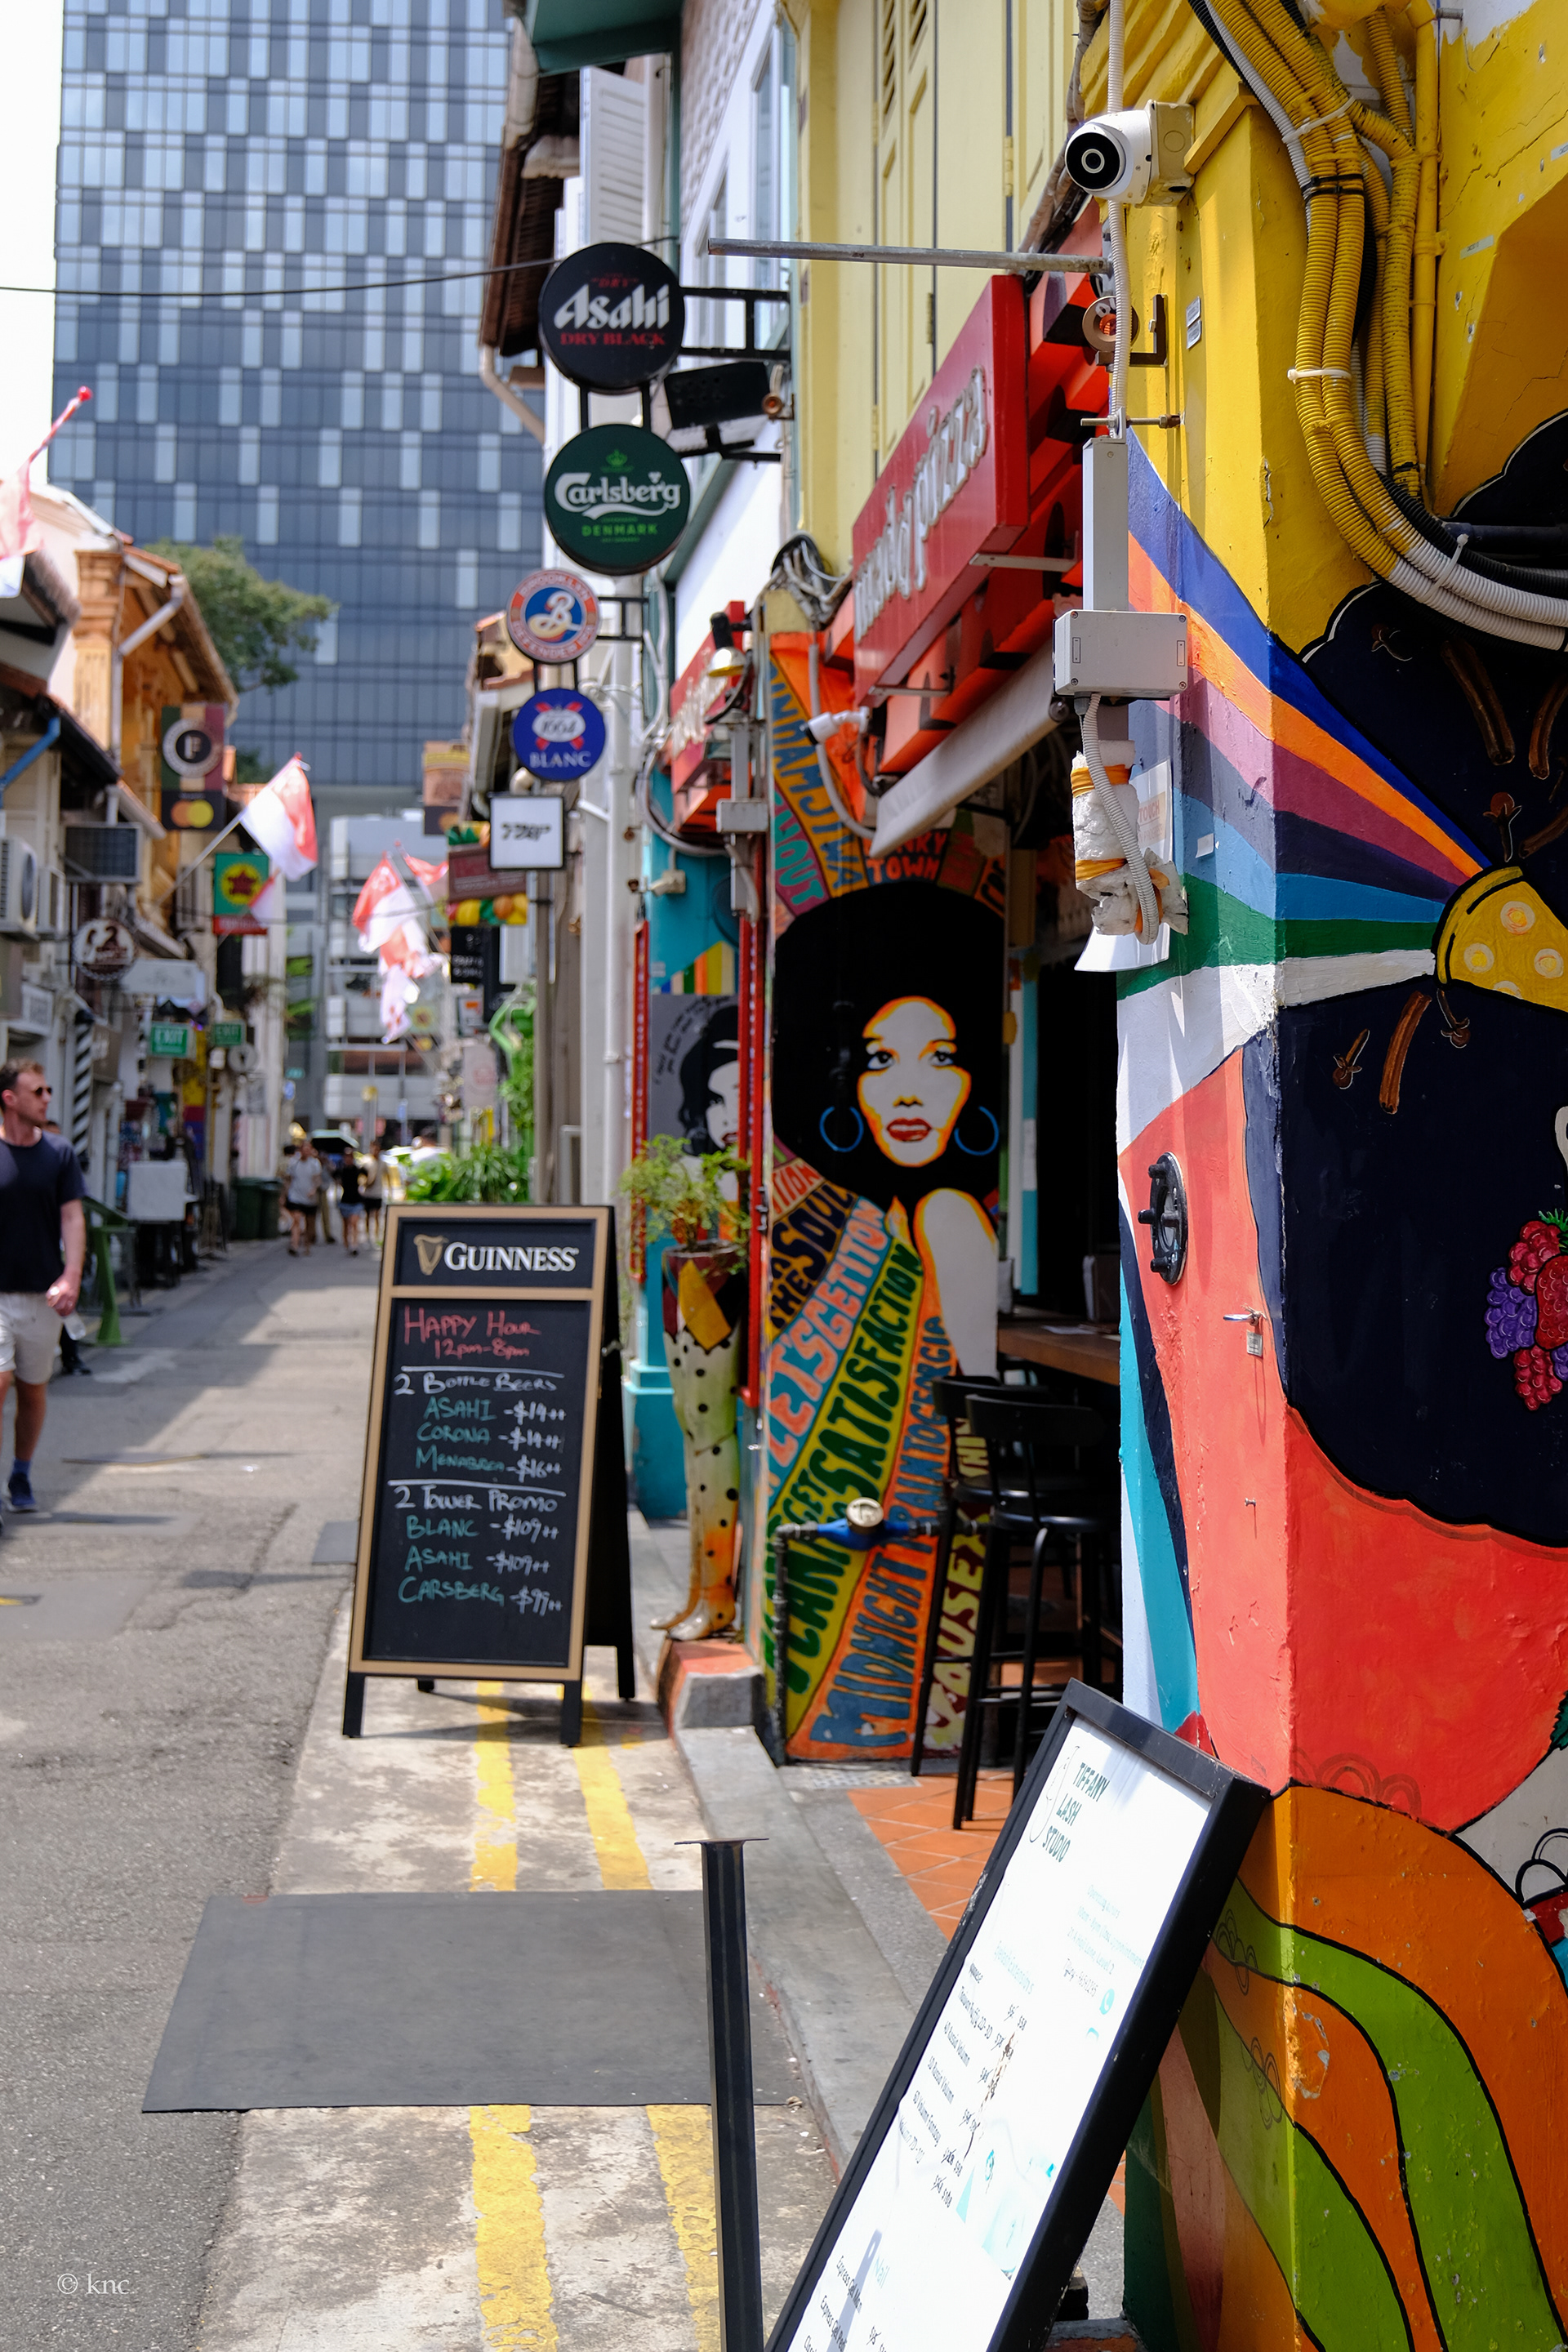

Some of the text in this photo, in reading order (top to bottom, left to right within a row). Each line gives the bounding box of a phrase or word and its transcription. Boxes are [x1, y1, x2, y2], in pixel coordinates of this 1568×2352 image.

[554, 284, 670, 329] Asahi
[561, 332, 666, 345] DRY BLACK
[555, 472, 681, 519] Carlsberg
[581, 523, 657, 537] DENMARK
[529, 751, 592, 768] BLANC
[866, 856, 941, 884] TOWN
[773, 1180, 855, 1282] SOUL
[444, 1241, 579, 1272] GUINNESS
[394, 1373, 415, 1395] 2
[810, 1243, 923, 1499] SATISFACTION
[422, 1396, 497, 1421] ASAHI
[416, 1422, 491, 1445] CORONA
[394, 1485, 416, 1509] 2
[406, 1514, 480, 1539] BLANC
[809, 1550, 928, 1748] MIDNIGHT
[911, 1316, 955, 1426] GEORGIA
[404, 1544, 474, 1573] ASAHI
[398, 1575, 505, 1607] CARSBERG
[1072, 1762, 1111, 1802] TIFFANY
[1055, 1793, 1082, 1827] LASH
[1041, 1825, 1071, 1863] STUDIO
[837, 2256, 850, 2286] Express
[848, 2279, 858, 2298] Gel
[821, 2296, 833, 2327] Express
[831, 2320, 842, 2340] Gel
